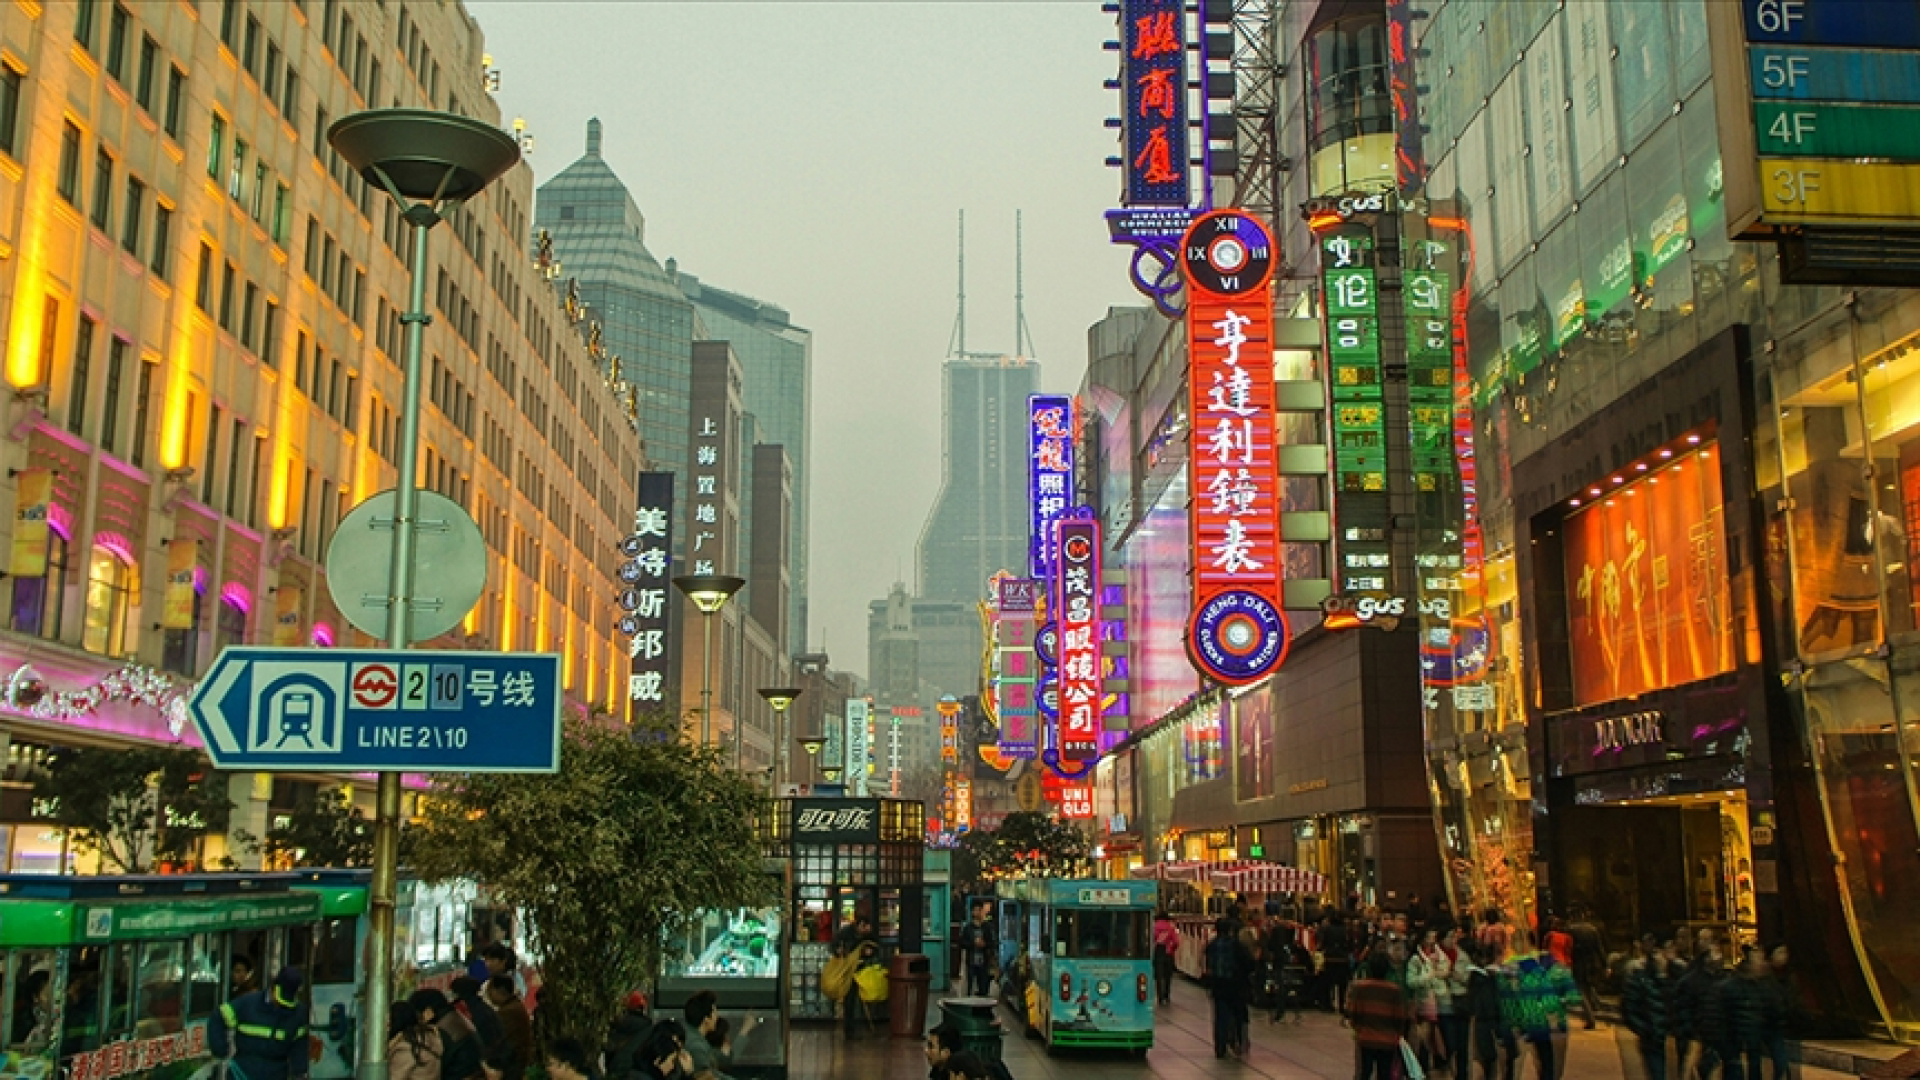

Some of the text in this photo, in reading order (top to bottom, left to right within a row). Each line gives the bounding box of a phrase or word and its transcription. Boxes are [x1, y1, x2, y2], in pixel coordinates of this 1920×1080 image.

[1757, 1, 1804, 32] 6F
[1763, 55, 1809, 88] 5F
[1768, 110, 1816, 144] 4F
[1773, 168, 1820, 204] 3F
[1214, 217, 1238, 231] XII
[1187, 247, 1206, 261] IX
[1220, 276, 1239, 290] VI
[1207, 309, 1264, 574] 亨達利鐘表
[695, 417, 717, 577] 上海置地广场
[629, 506, 667, 702] 美特斯邦威
[1203, 595, 1275, 623] HENG DALI
[408, 669, 535, 707] 2 10 号线
[358, 727, 413, 748] LINE
[1063, 788, 1089, 800] UNI
[1063, 802, 1090, 816] QLO
